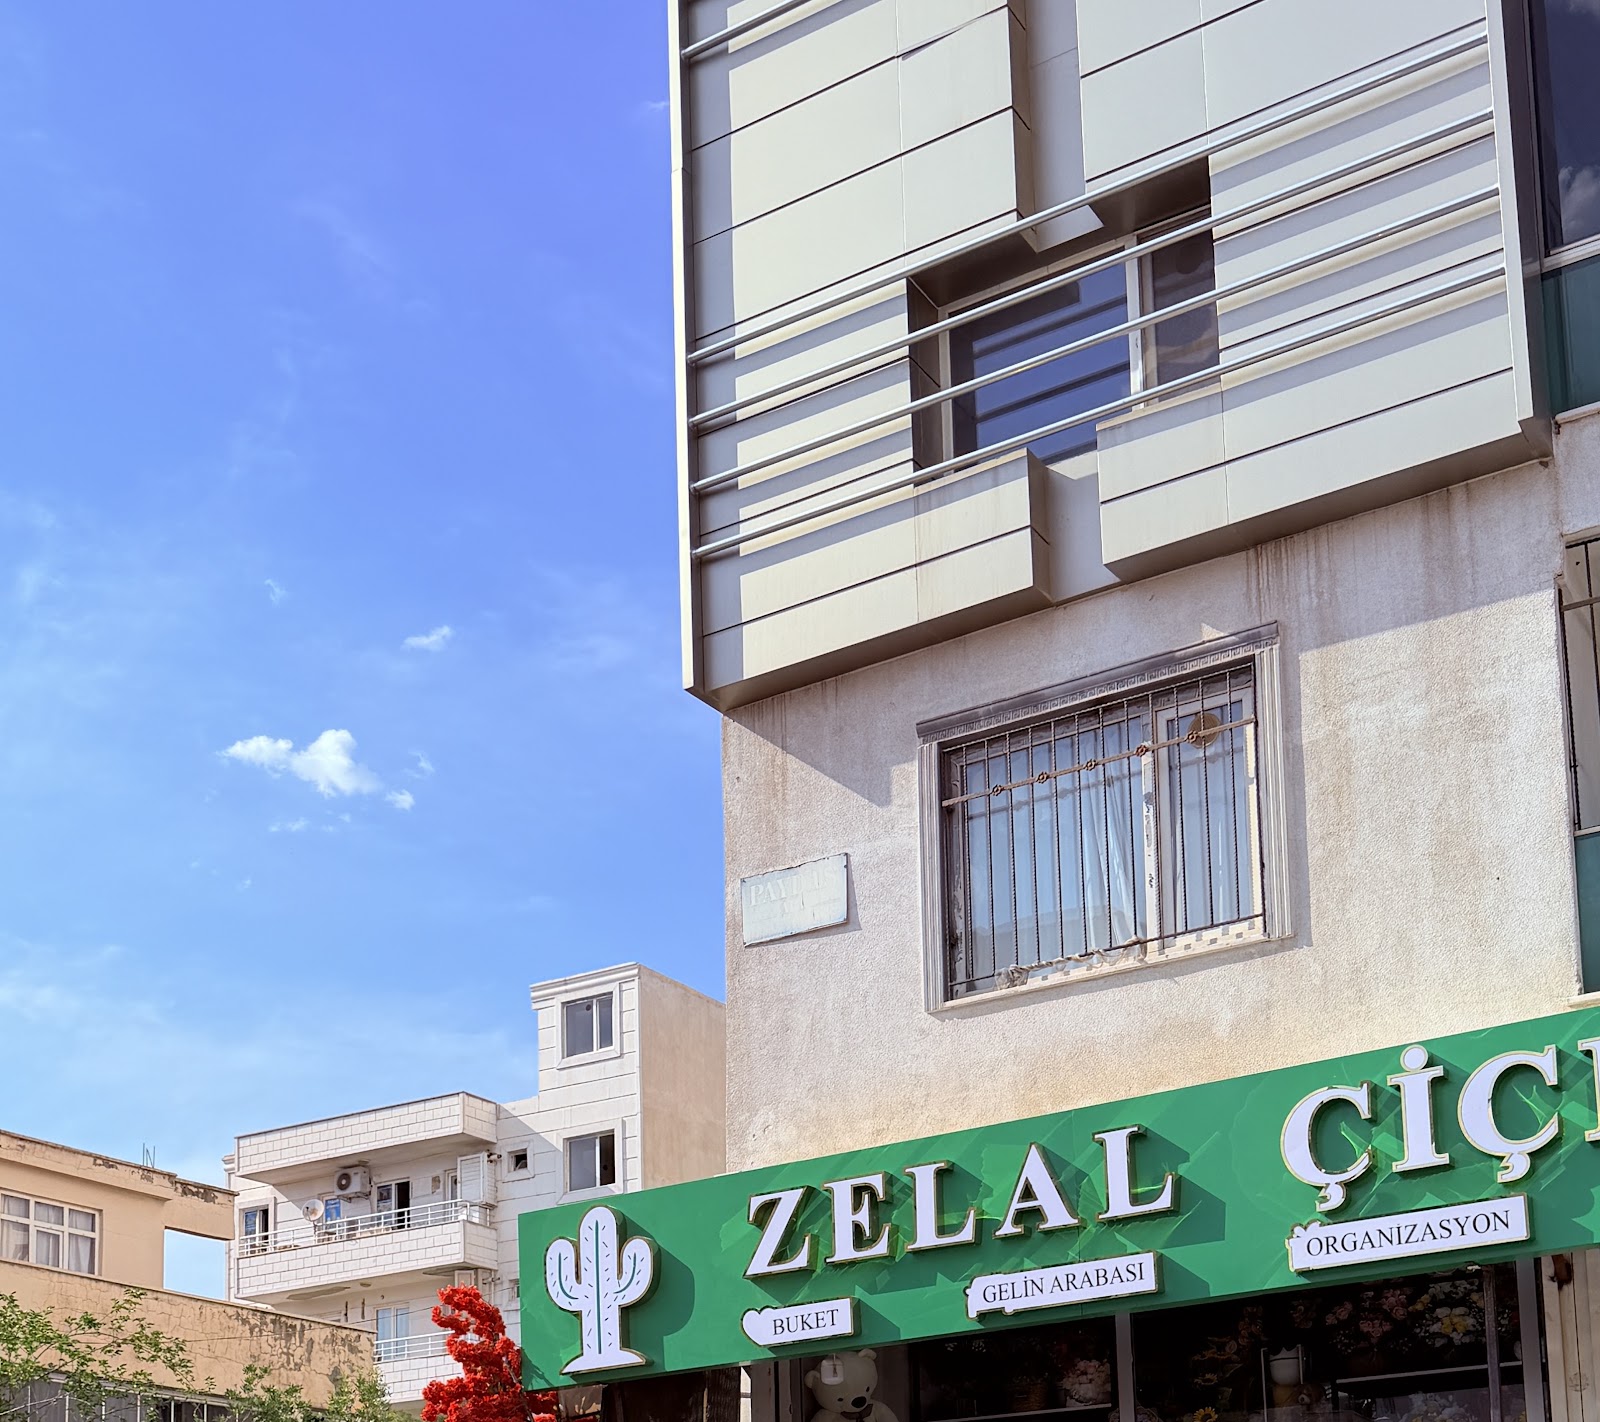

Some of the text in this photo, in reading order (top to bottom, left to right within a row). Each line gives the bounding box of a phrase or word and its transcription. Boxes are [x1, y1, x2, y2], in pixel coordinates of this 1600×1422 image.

[743, 1124, 1178, 1278] ZELAL
[1306, 1209, 1511, 1257] ORGANİZASYON
[982, 1262, 1146, 1304] GELİN ARABASI
[772, 1308, 839, 1336] BUKET
